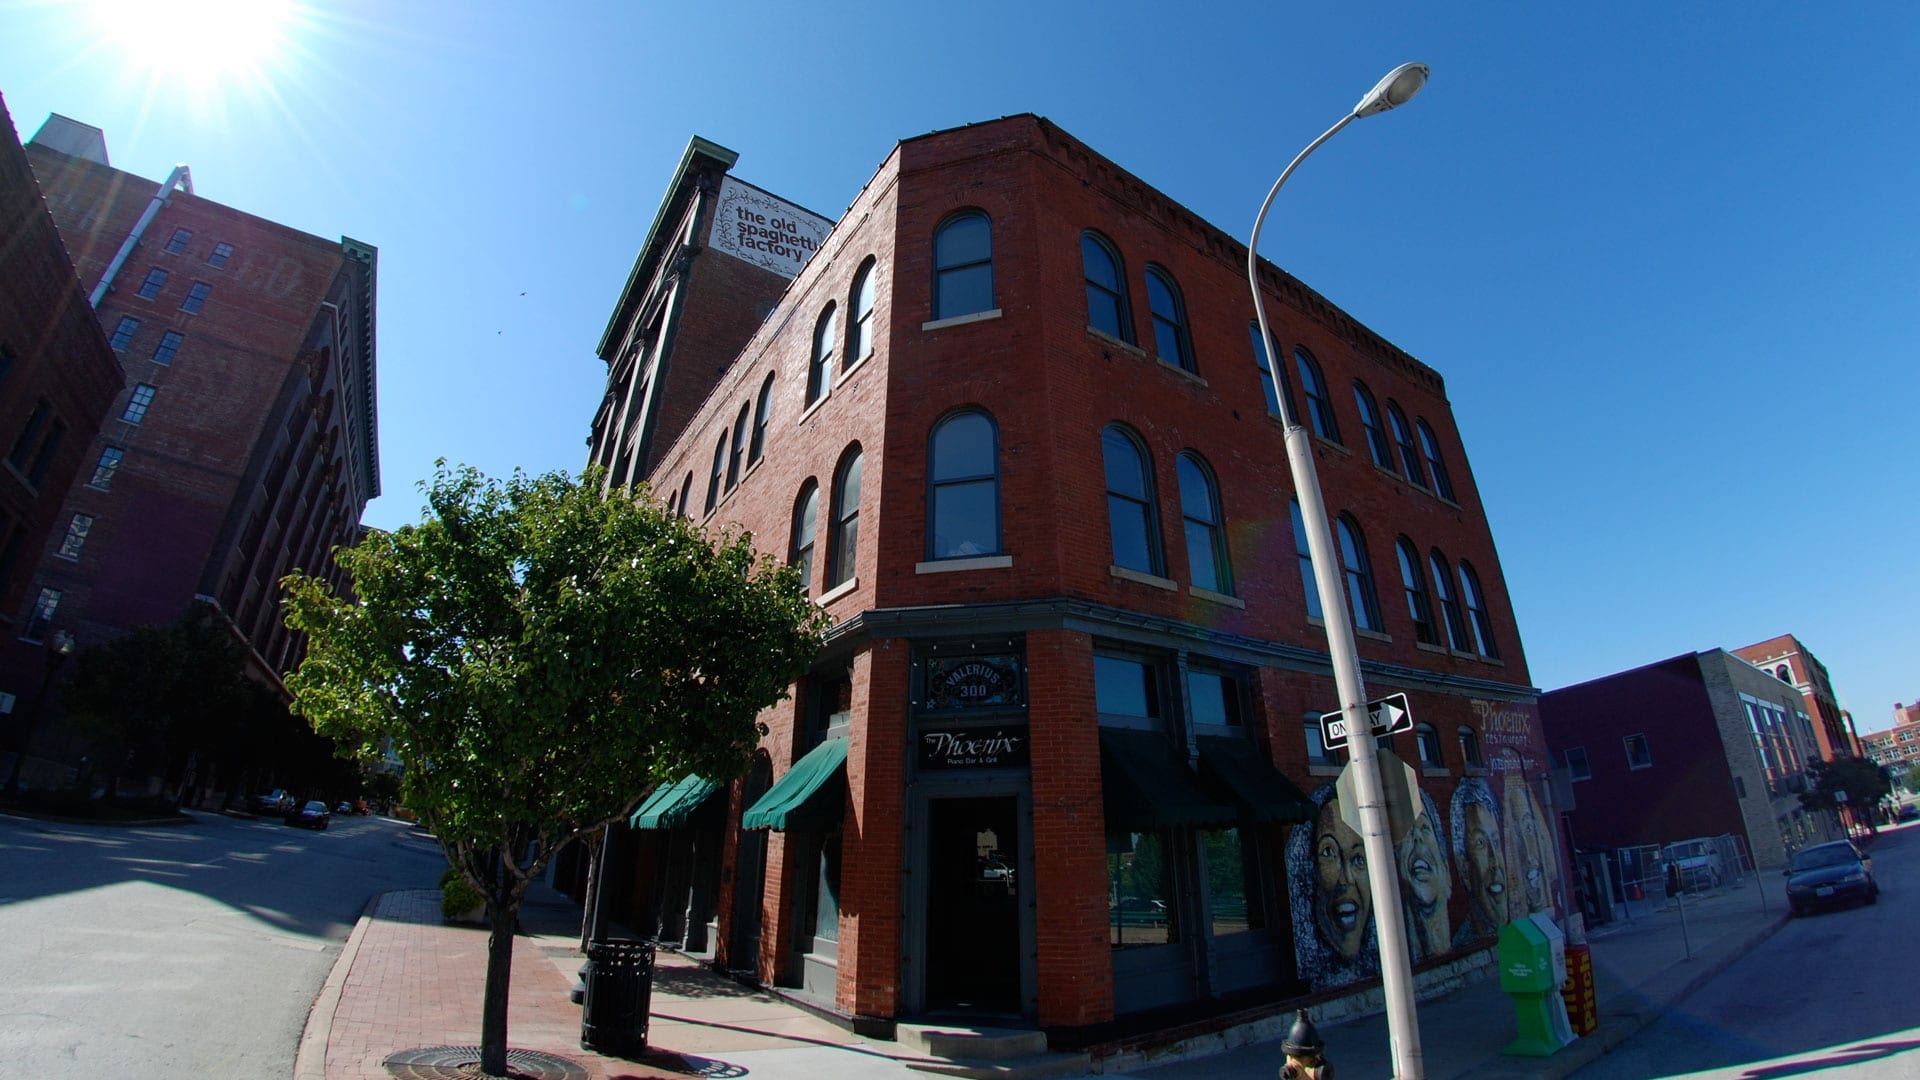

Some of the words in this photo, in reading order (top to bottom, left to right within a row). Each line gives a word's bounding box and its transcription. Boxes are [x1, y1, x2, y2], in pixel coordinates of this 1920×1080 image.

[736, 206, 765, 223] the
[770, 217, 797, 234] old
[737, 233, 802, 262] factory
[946, 664, 1000, 687] VALERIUS
[960, 685, 987, 697] 300
[924, 730, 1022, 757] Phoenix
